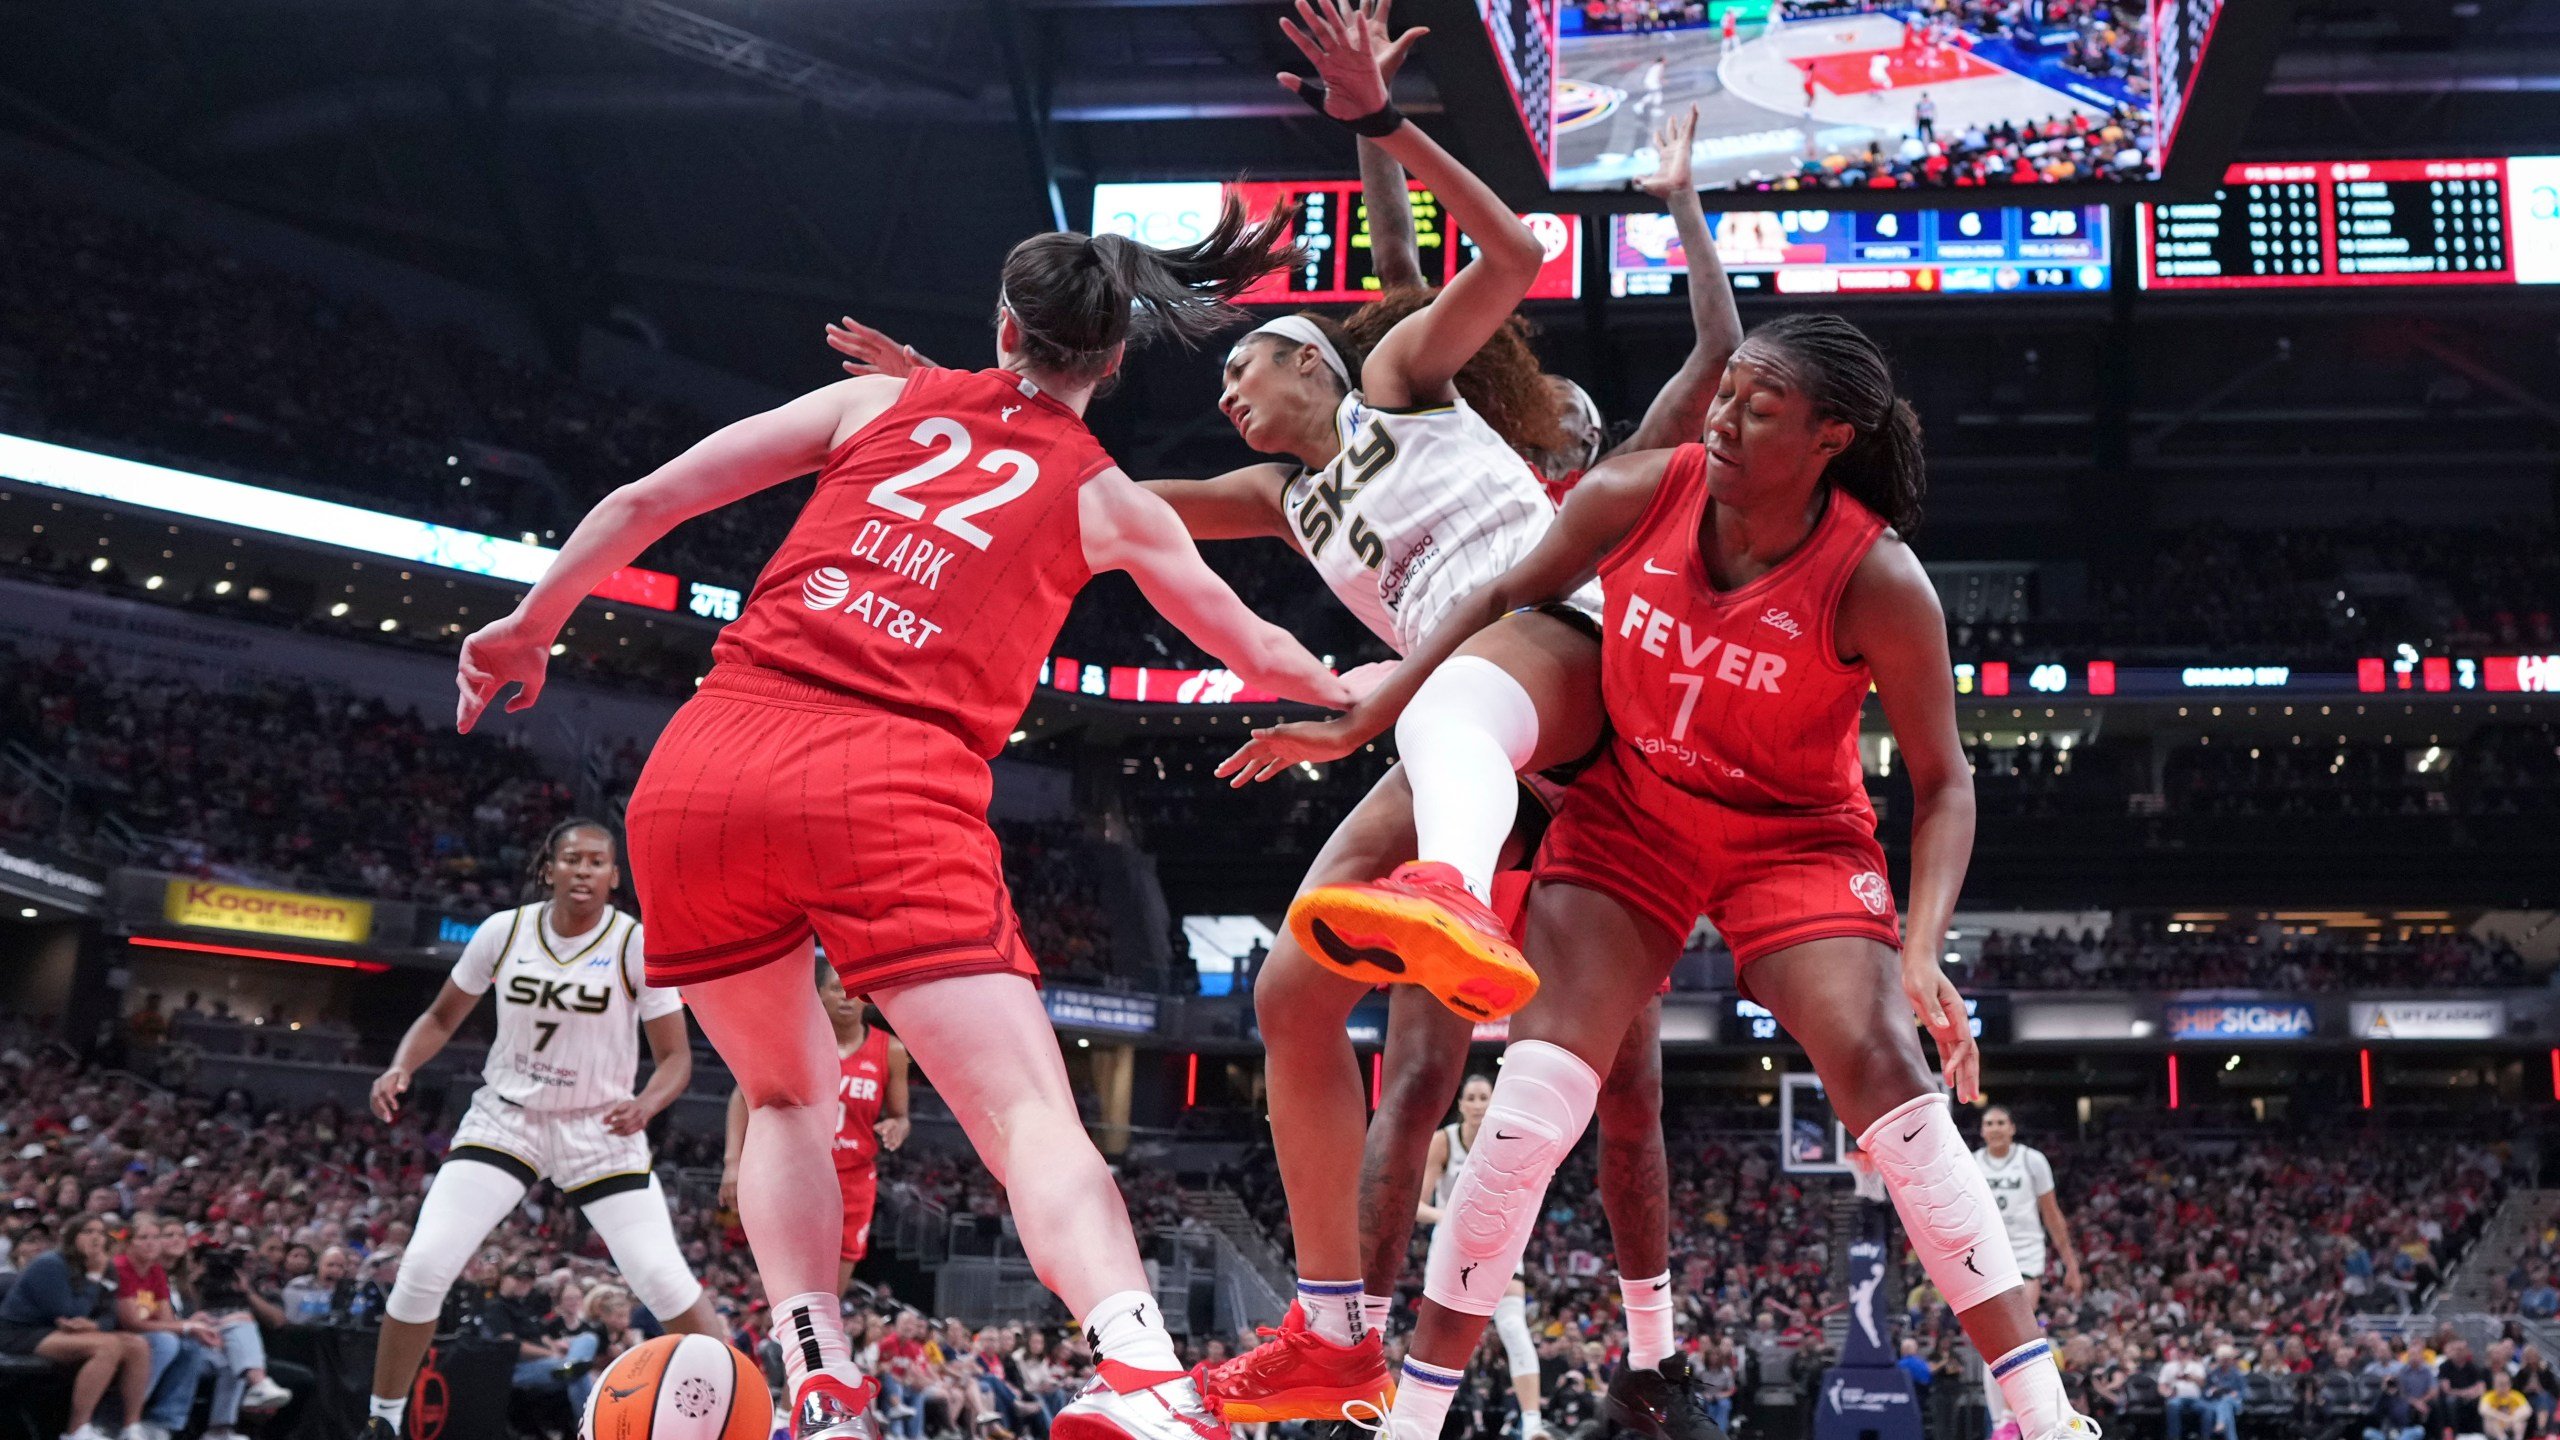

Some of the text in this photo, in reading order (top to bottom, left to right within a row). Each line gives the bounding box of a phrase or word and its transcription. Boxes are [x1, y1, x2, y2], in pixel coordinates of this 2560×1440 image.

[1876, 213, 1898, 237] 4
[1959, 211, 1982, 237] 6
[866, 416, 1040, 551] 22
[1299, 417, 1400, 560] SKY
[851, 519, 955, 591] CLARK
[1349, 513, 1386, 570] 5
[844, 590, 943, 649] AT&T
[1760, 607, 1803, 640] Lilly
[1620, 594, 1788, 694] FEVER
[2029, 664, 2066, 692] 40
[1669, 673, 1704, 742] 7
[187, 885, 346, 922] Koorsen
[505, 976, 611, 1014] SKY
[535, 1022, 561, 1052] 7
